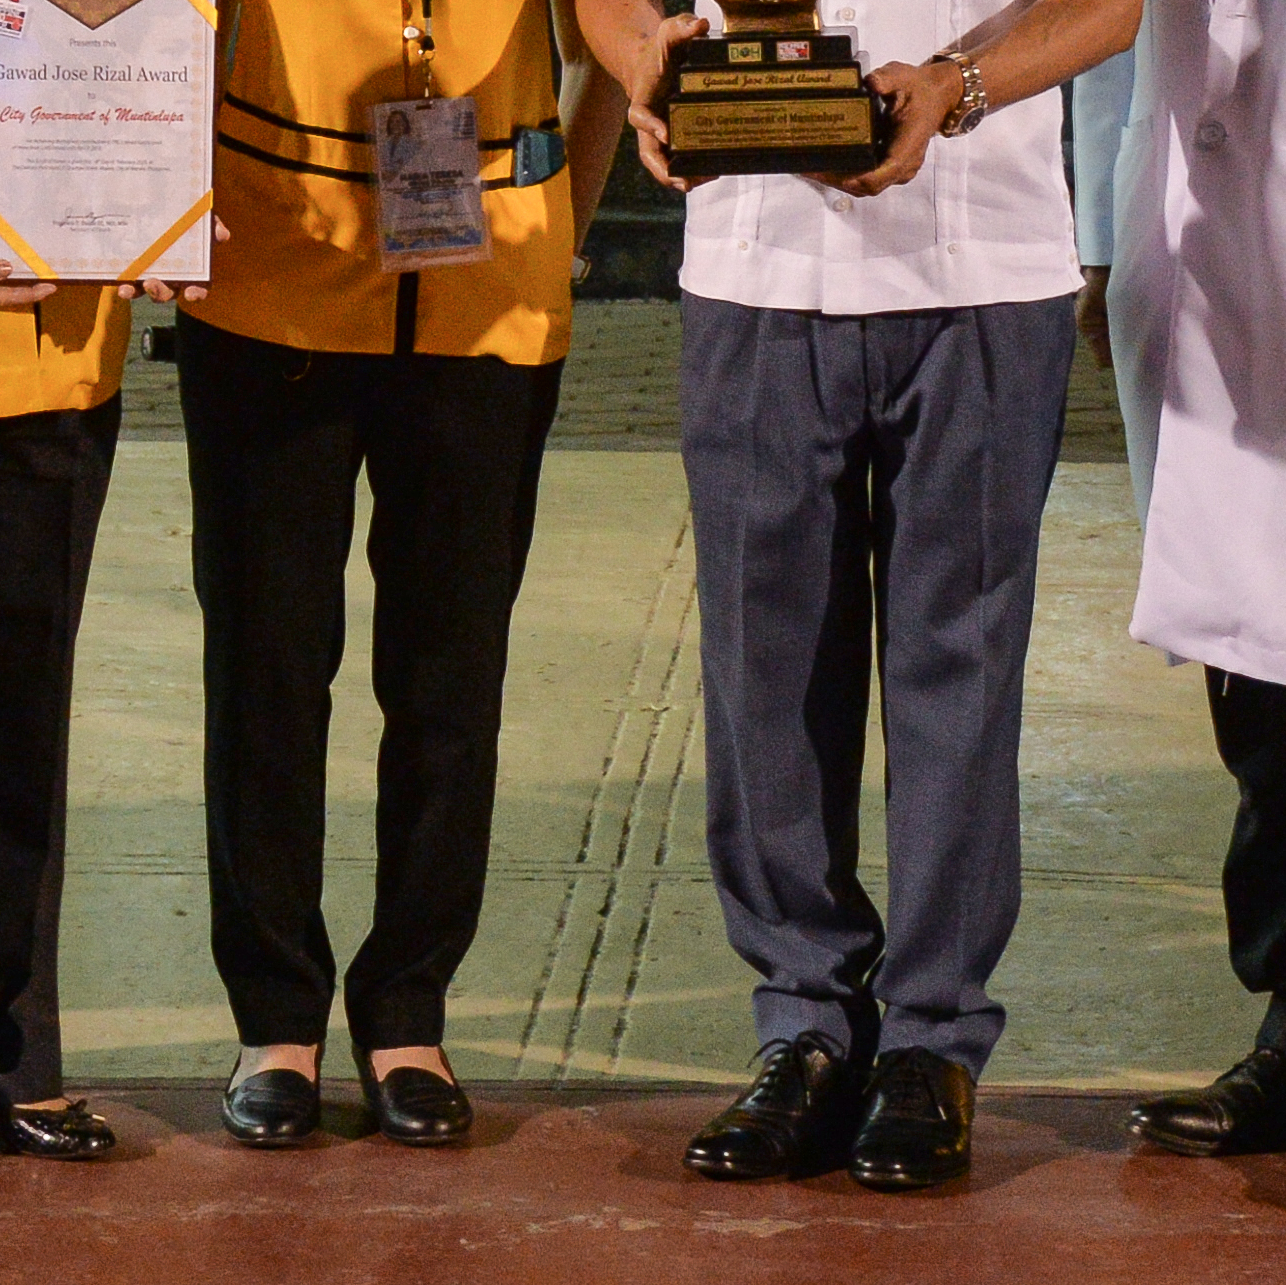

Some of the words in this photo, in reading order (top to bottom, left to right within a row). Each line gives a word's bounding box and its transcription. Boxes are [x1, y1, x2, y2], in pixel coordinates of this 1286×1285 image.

[69, 38, 101, 47] Presents
[102, 38, 117, 47] this
[730, 46, 761, 59] DOH
[52, 65, 88, 81] Jose
[93, 65, 132, 82] Rizal
[136, 66, 188, 83] Award
[703, 76, 739, 88] Gawad
[742, 75, 763, 86] Jose
[765, 75, 794, 85] Rizal
[796, 73, 832, 83] Award
[87, 91, 96, 100] to
[0, 106, 25, 124] City
[30, 106, 96, 125] Government
[99, 108, 110, 126] of
[115, 107, 185, 125] Muntinlupa
[695, 115, 713, 127] City
[715, 114, 775, 126] Government
[778, 113, 787, 124] of
[789, 112, 846, 125] Muntinlupa
